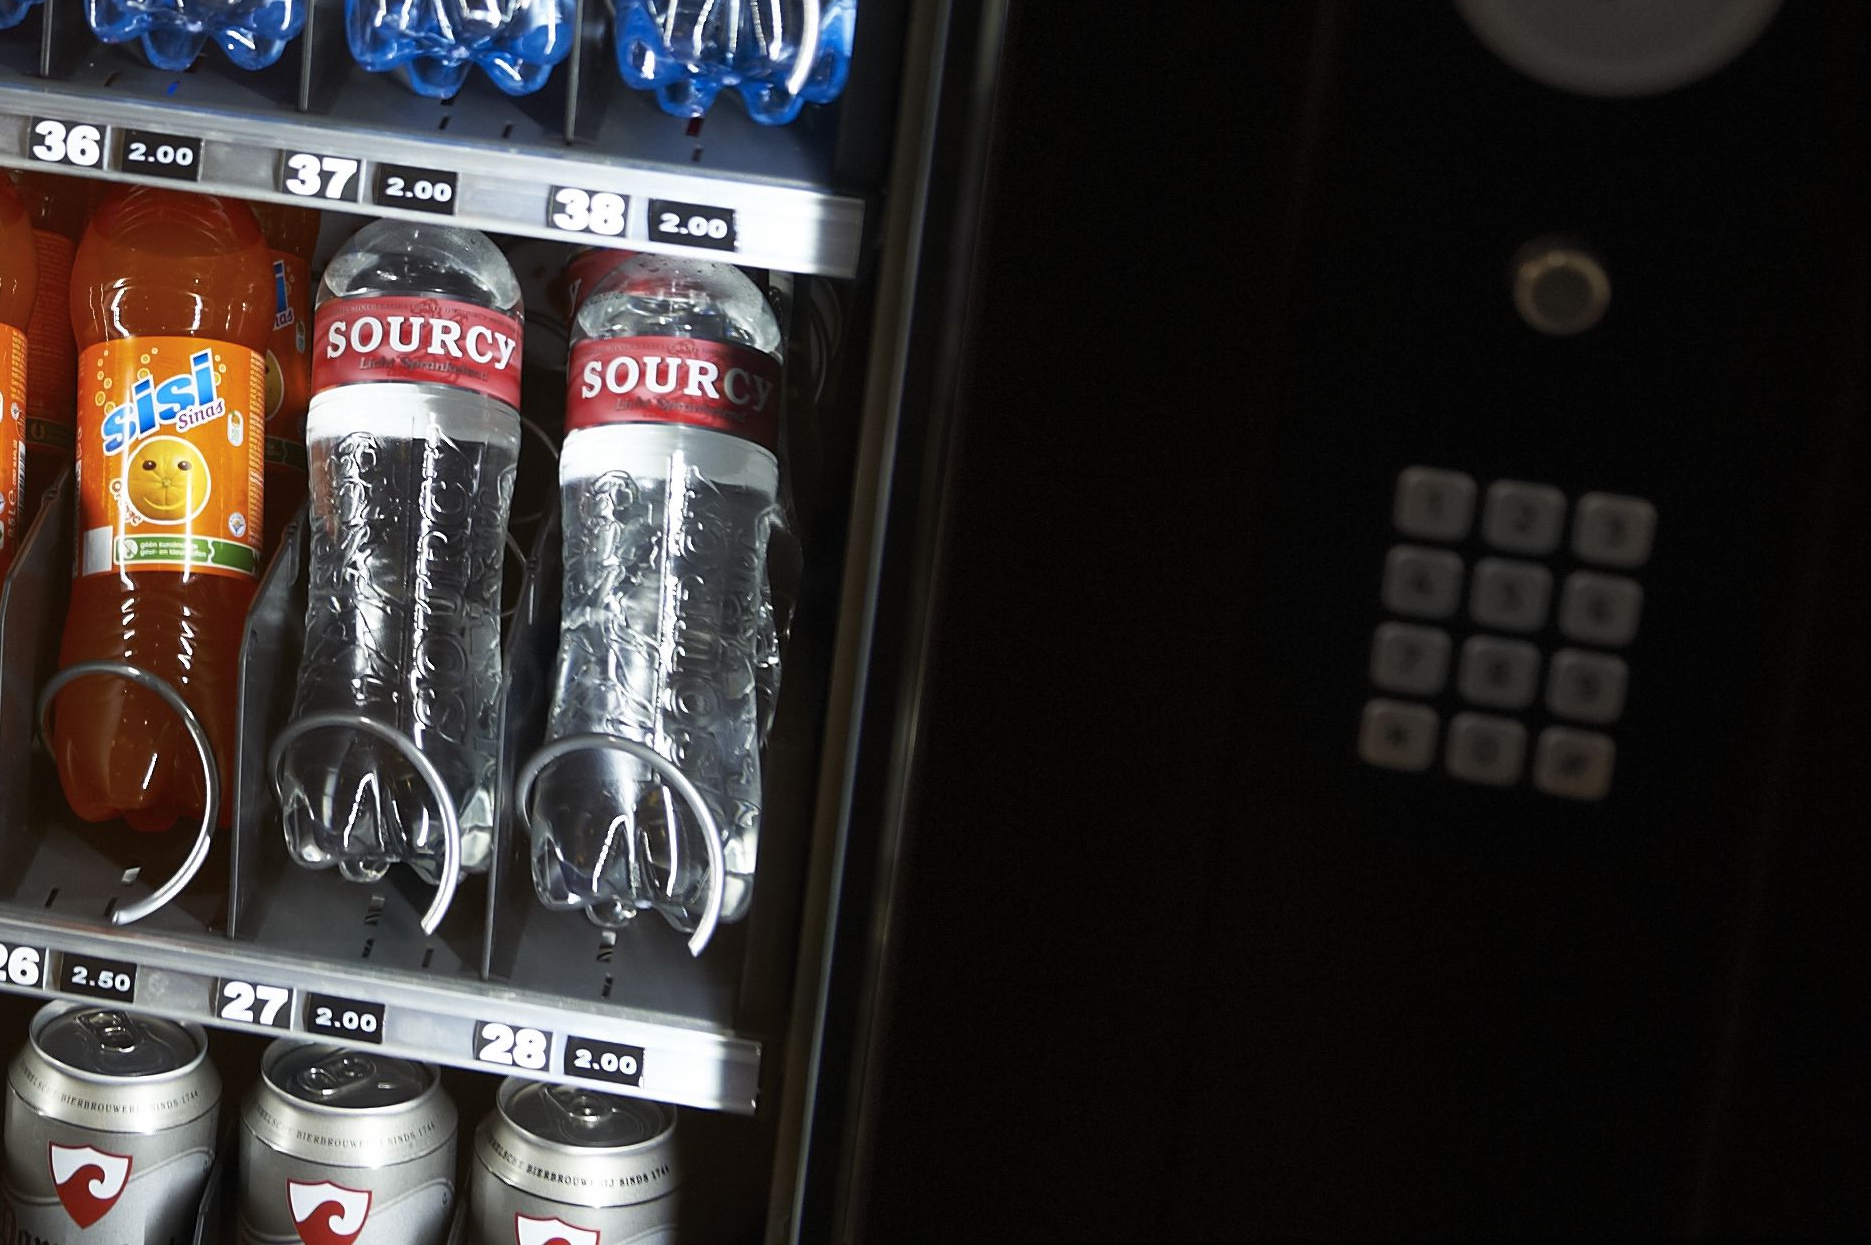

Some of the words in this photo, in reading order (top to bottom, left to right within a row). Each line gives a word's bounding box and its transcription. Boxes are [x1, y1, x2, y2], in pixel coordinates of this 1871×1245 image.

[32, 121, 102, 167] 36
[128, 141, 194, 167] 2.00
[285, 153, 359, 200] 37
[384, 176, 453, 204] 2.00
[553, 187, 627, 237] 38
[659, 212, 728, 240] 2.00
[326, 315, 517, 371] SOURCY
[102, 348, 217, 454] sisi
[581, 355, 774, 412] SOURCY
[178, 400, 224, 430] Sinas
[70, 966, 132, 992] 2.50
[221, 981, 290, 1025] 27
[314, 1008, 379, 1034] 2.00
[479, 1022, 548, 1070] 28
[573, 1048, 639, 1077] 2.00
[60, 1093, 146, 1114] BIERBROUWER
[525, 1164, 615, 1189] BIERBROUWIJ
